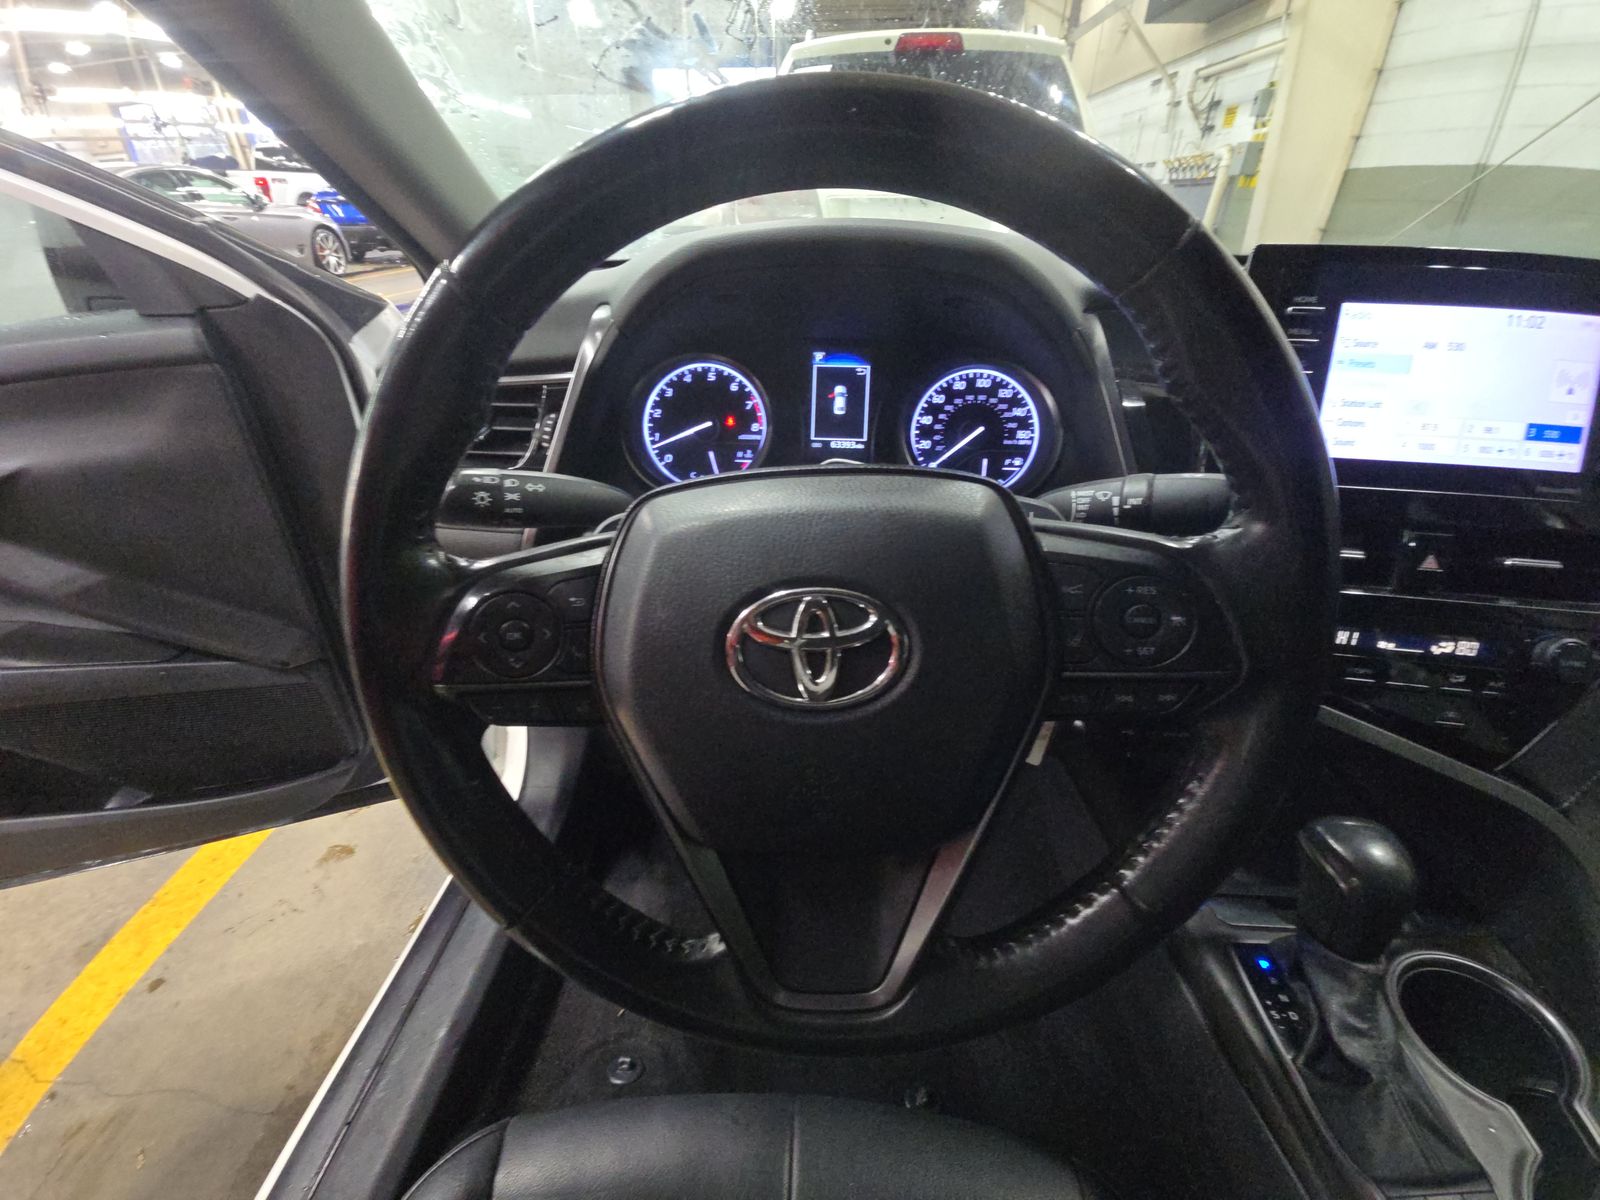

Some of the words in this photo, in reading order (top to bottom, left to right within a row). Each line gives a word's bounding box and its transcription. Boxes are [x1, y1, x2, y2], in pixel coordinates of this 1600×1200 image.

[683, 374, 692, 382] 4
[707, 372, 716, 381] 5
[729, 382, 739, 391] 6
[952, 381, 967, 390] 80
[976, 379, 992, 387] 100
[664, 388, 673, 397] 3
[745, 401, 753, 410] 7
[653, 409, 662, 418] 2
[750, 423, 759, 431] 8
[664, 454, 673, 463] 0
